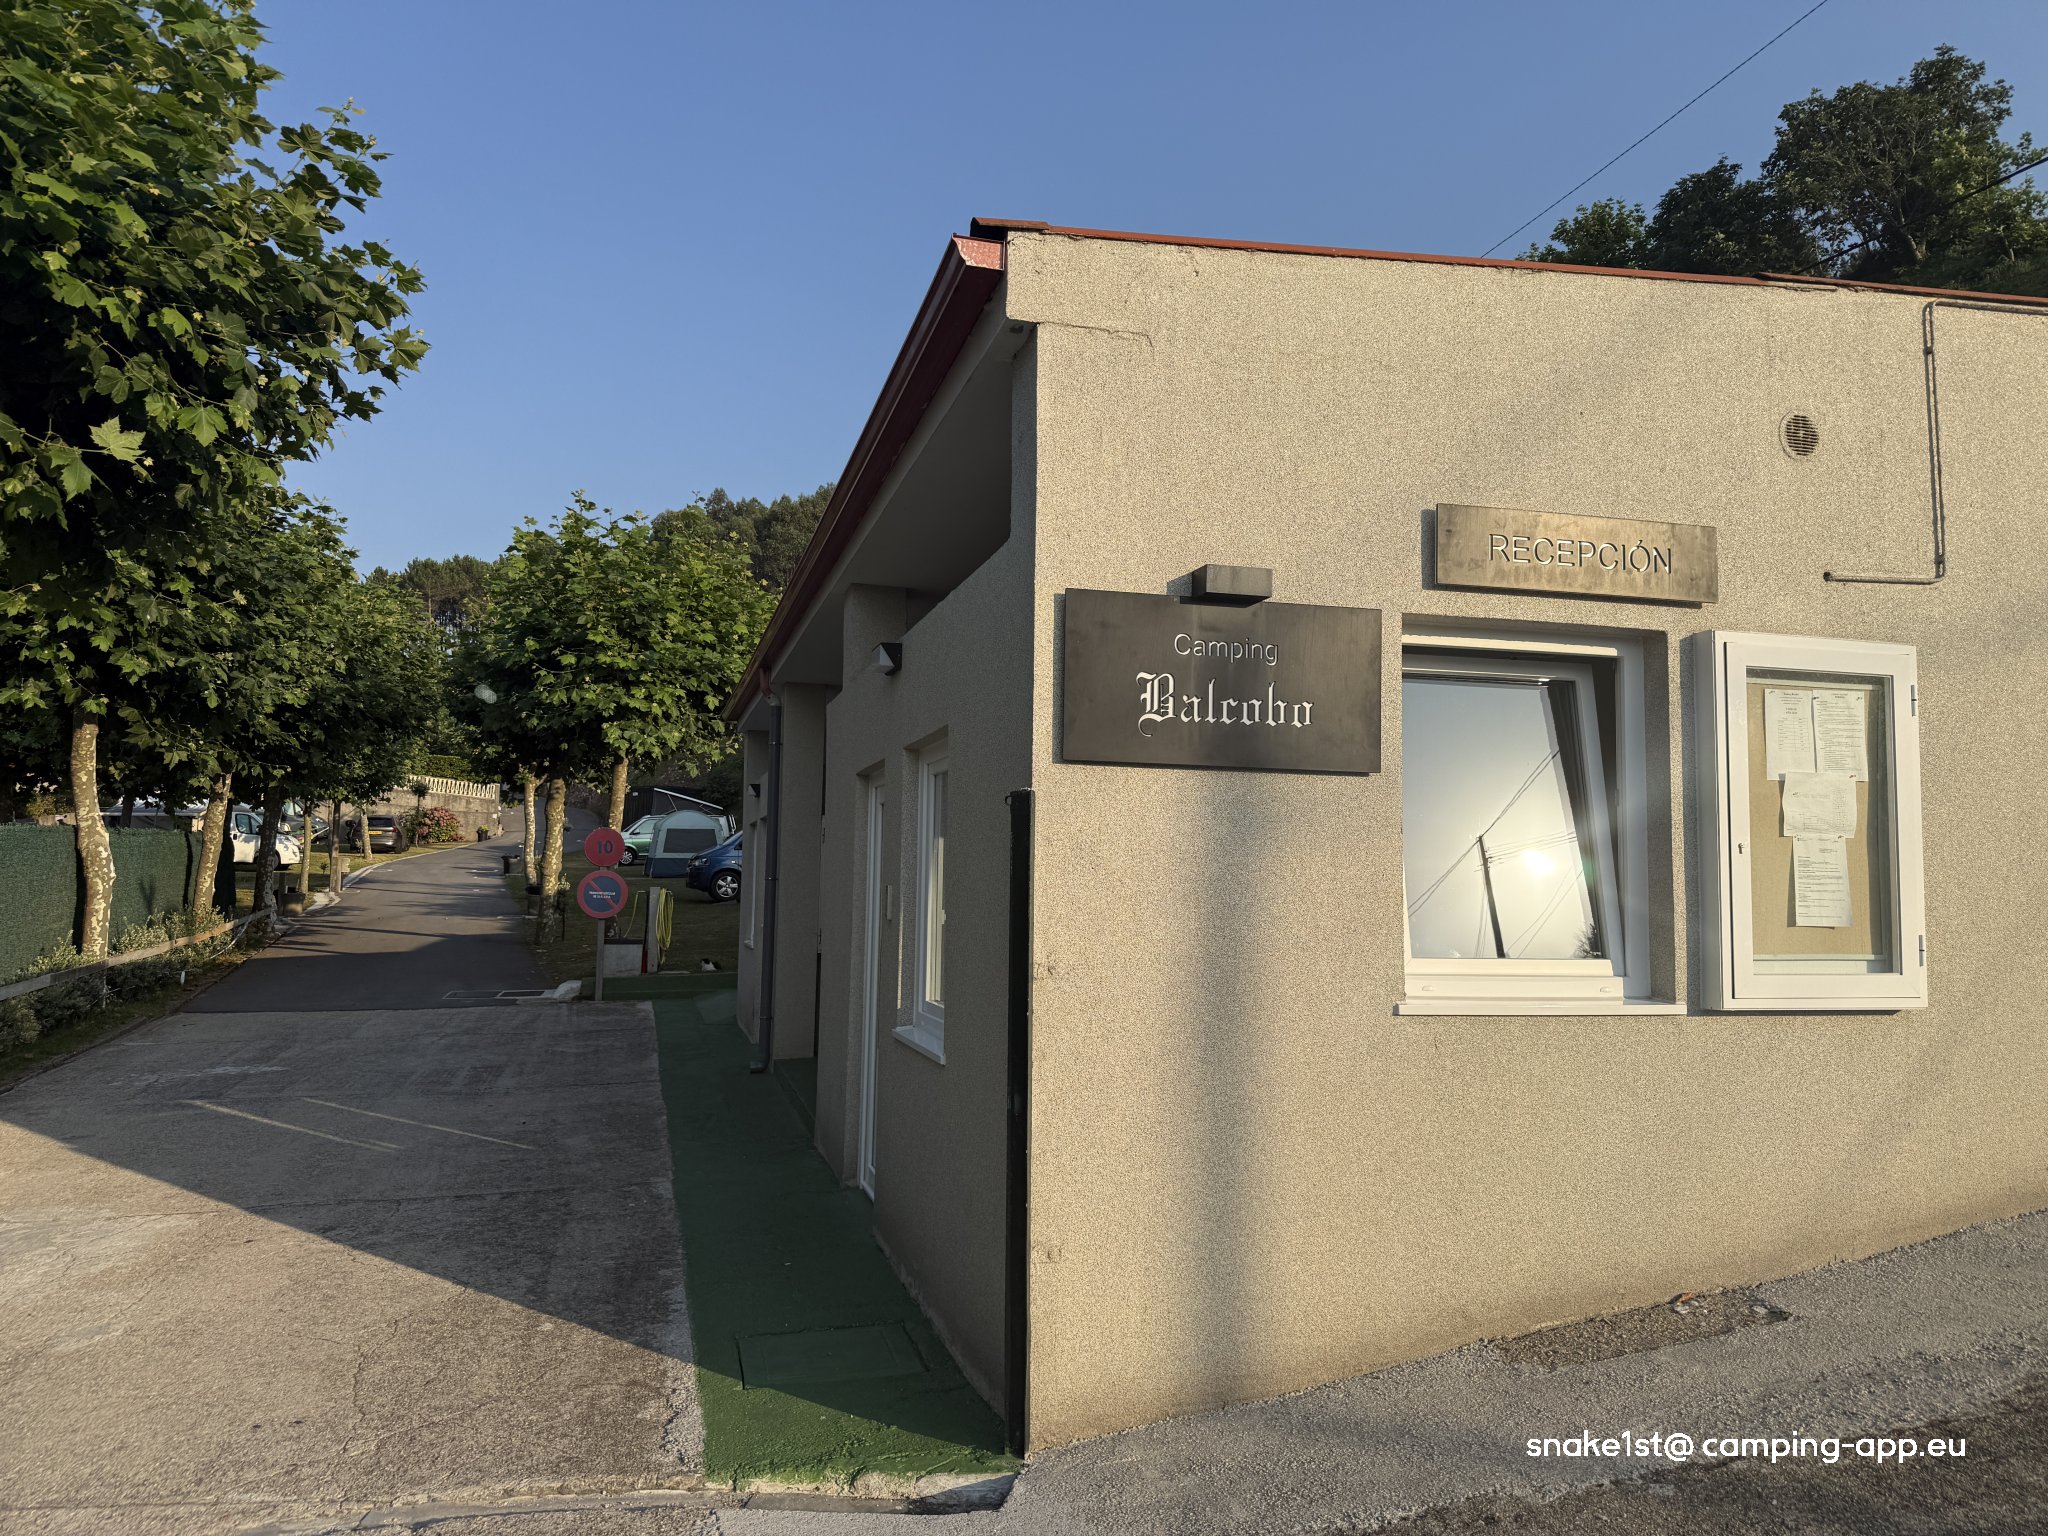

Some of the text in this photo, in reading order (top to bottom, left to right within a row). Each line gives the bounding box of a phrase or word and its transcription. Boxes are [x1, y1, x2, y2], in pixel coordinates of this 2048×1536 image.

[1488, 533, 1672, 574] RECEPCIÓN
[1174, 633, 1279, 666] Camping
[1136, 671, 1314, 737] Balcobo
[597, 841, 614, 854] 10
